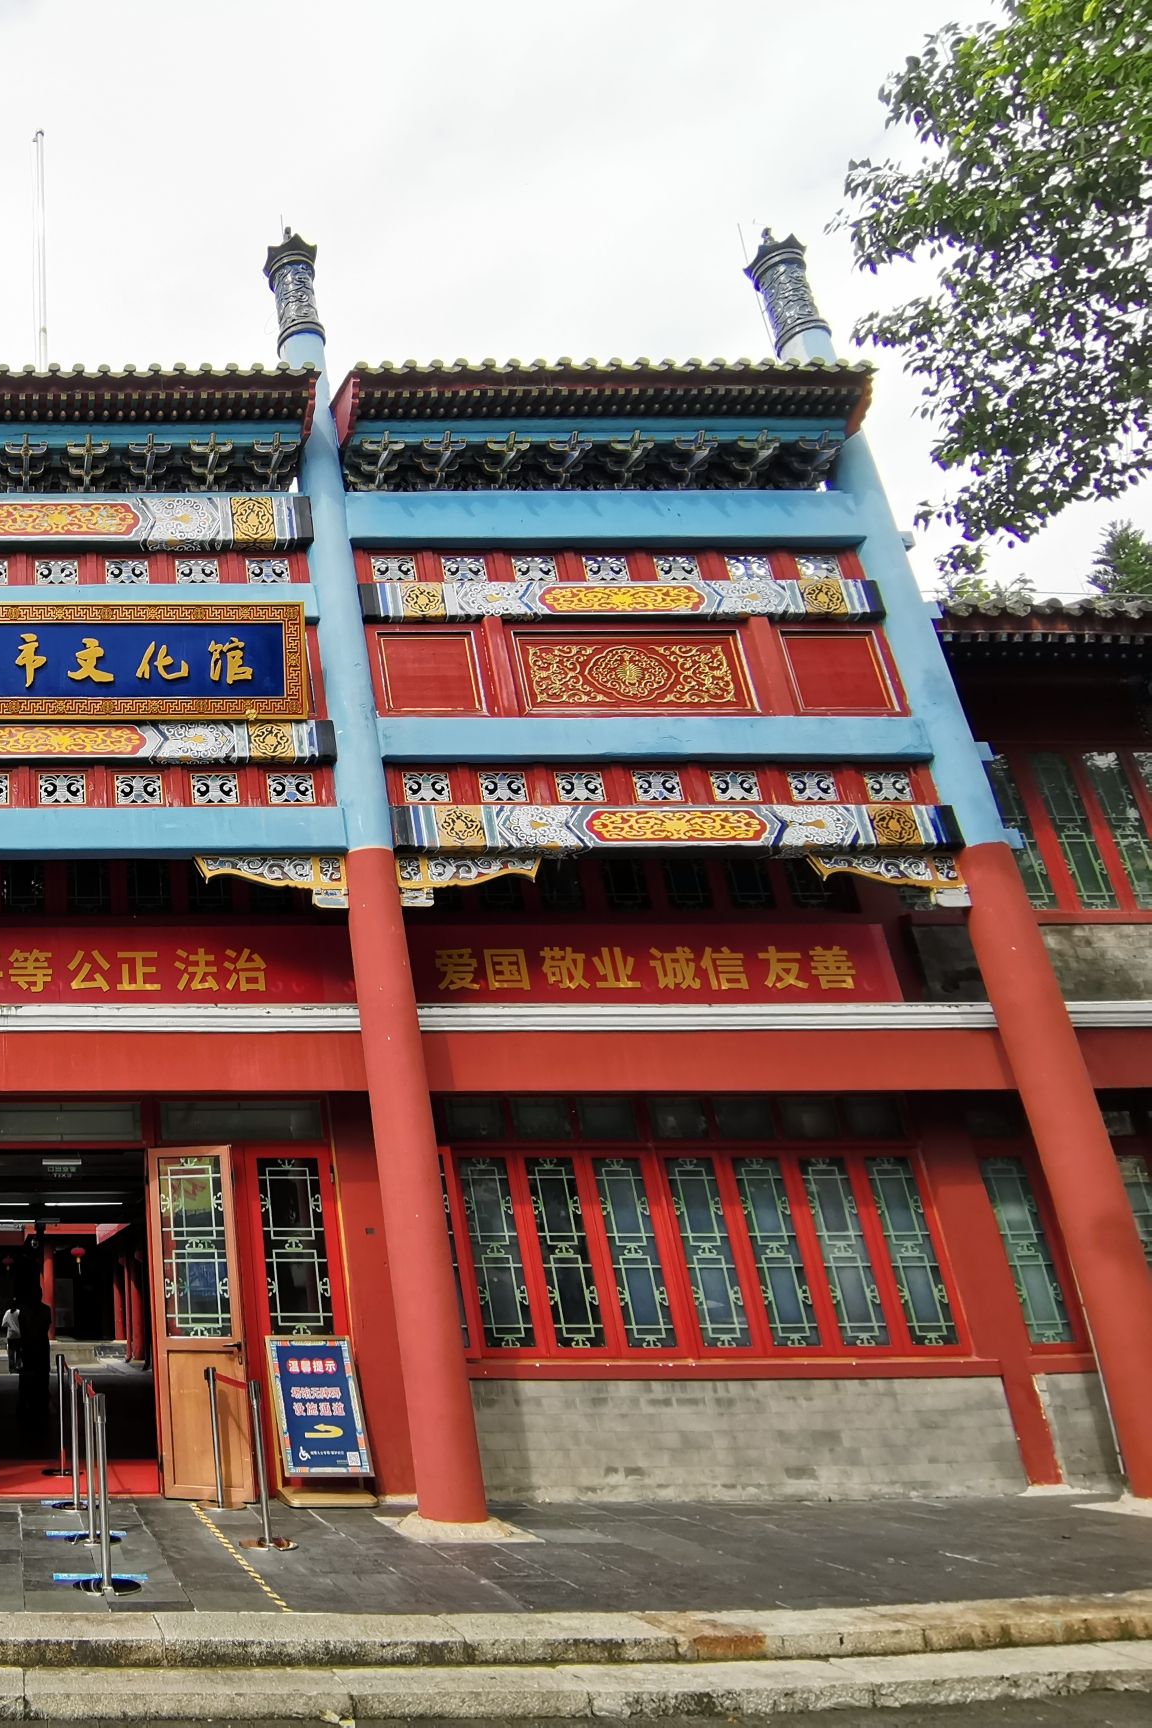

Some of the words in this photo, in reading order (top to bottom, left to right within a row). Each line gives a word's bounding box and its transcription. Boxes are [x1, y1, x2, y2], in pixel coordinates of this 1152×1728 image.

[435, 945, 857, 991] 爱国敬业诚信友善
[288, 1360, 336, 1373] 温馨提示
